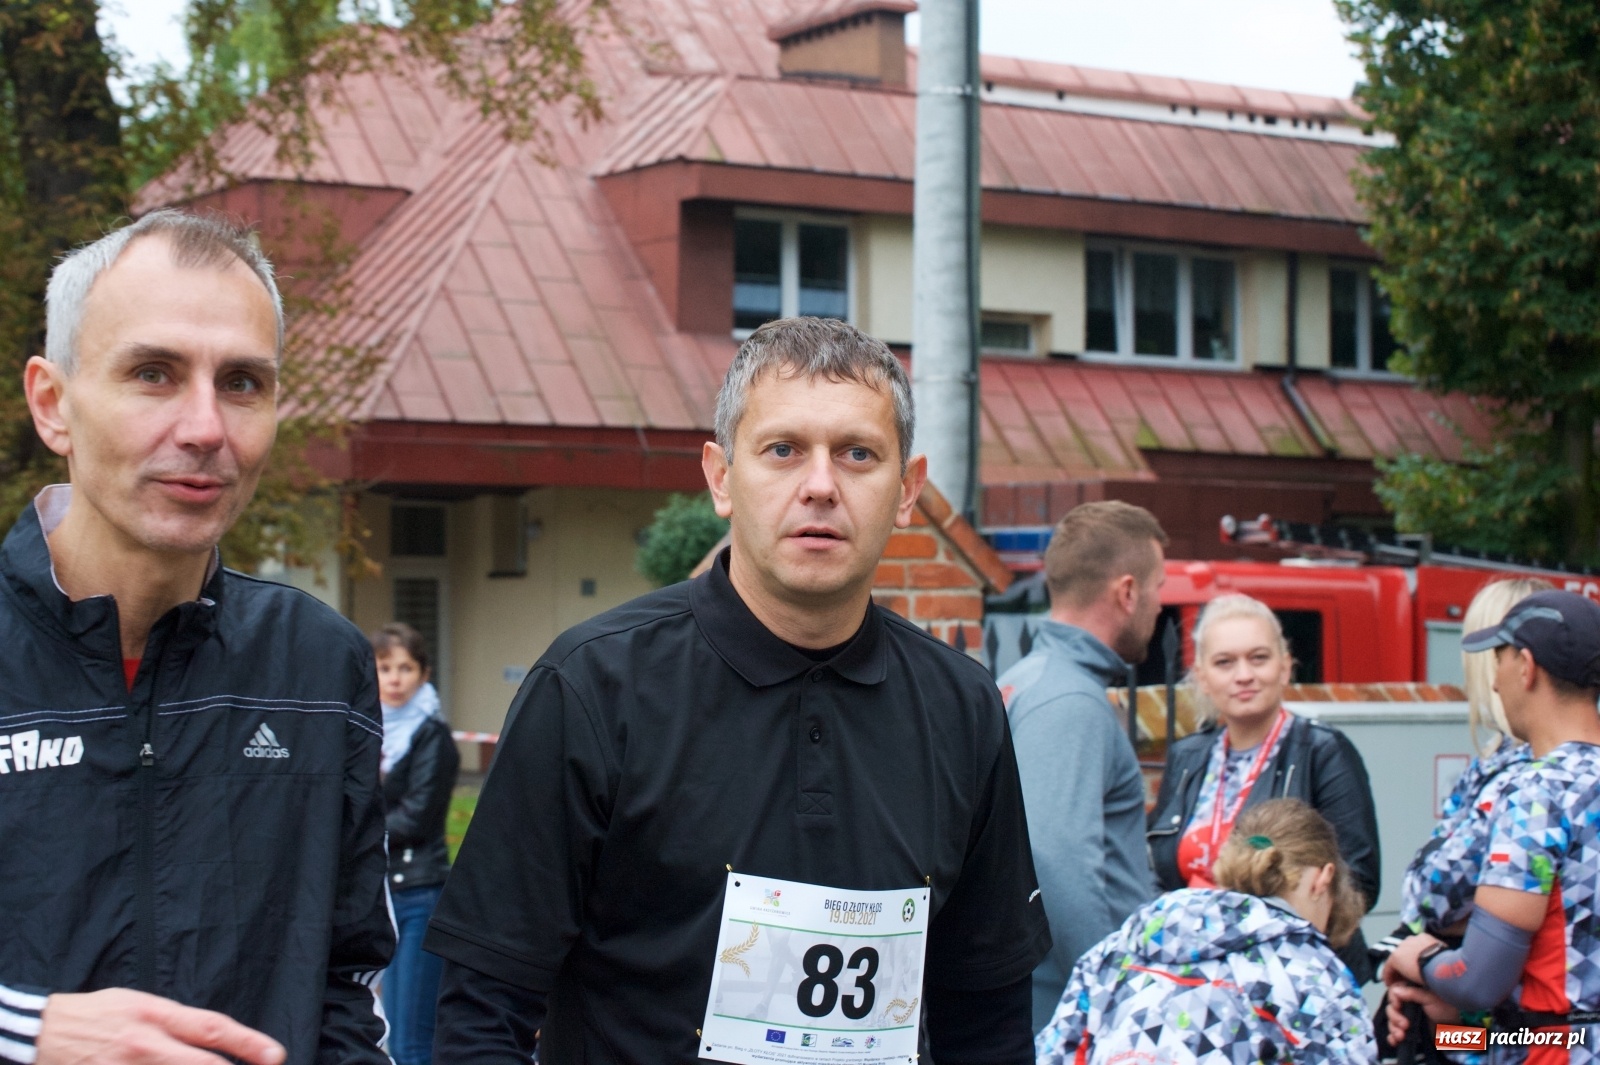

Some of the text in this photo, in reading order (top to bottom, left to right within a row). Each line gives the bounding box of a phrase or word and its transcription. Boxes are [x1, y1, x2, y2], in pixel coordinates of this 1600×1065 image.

[243, 743, 290, 758] adidas
[824, 899, 882, 913] BIEG O ZŁOTY KŁOS
[829, 909, 877, 925] 19.09.2021
[797, 943, 879, 1020] 83
